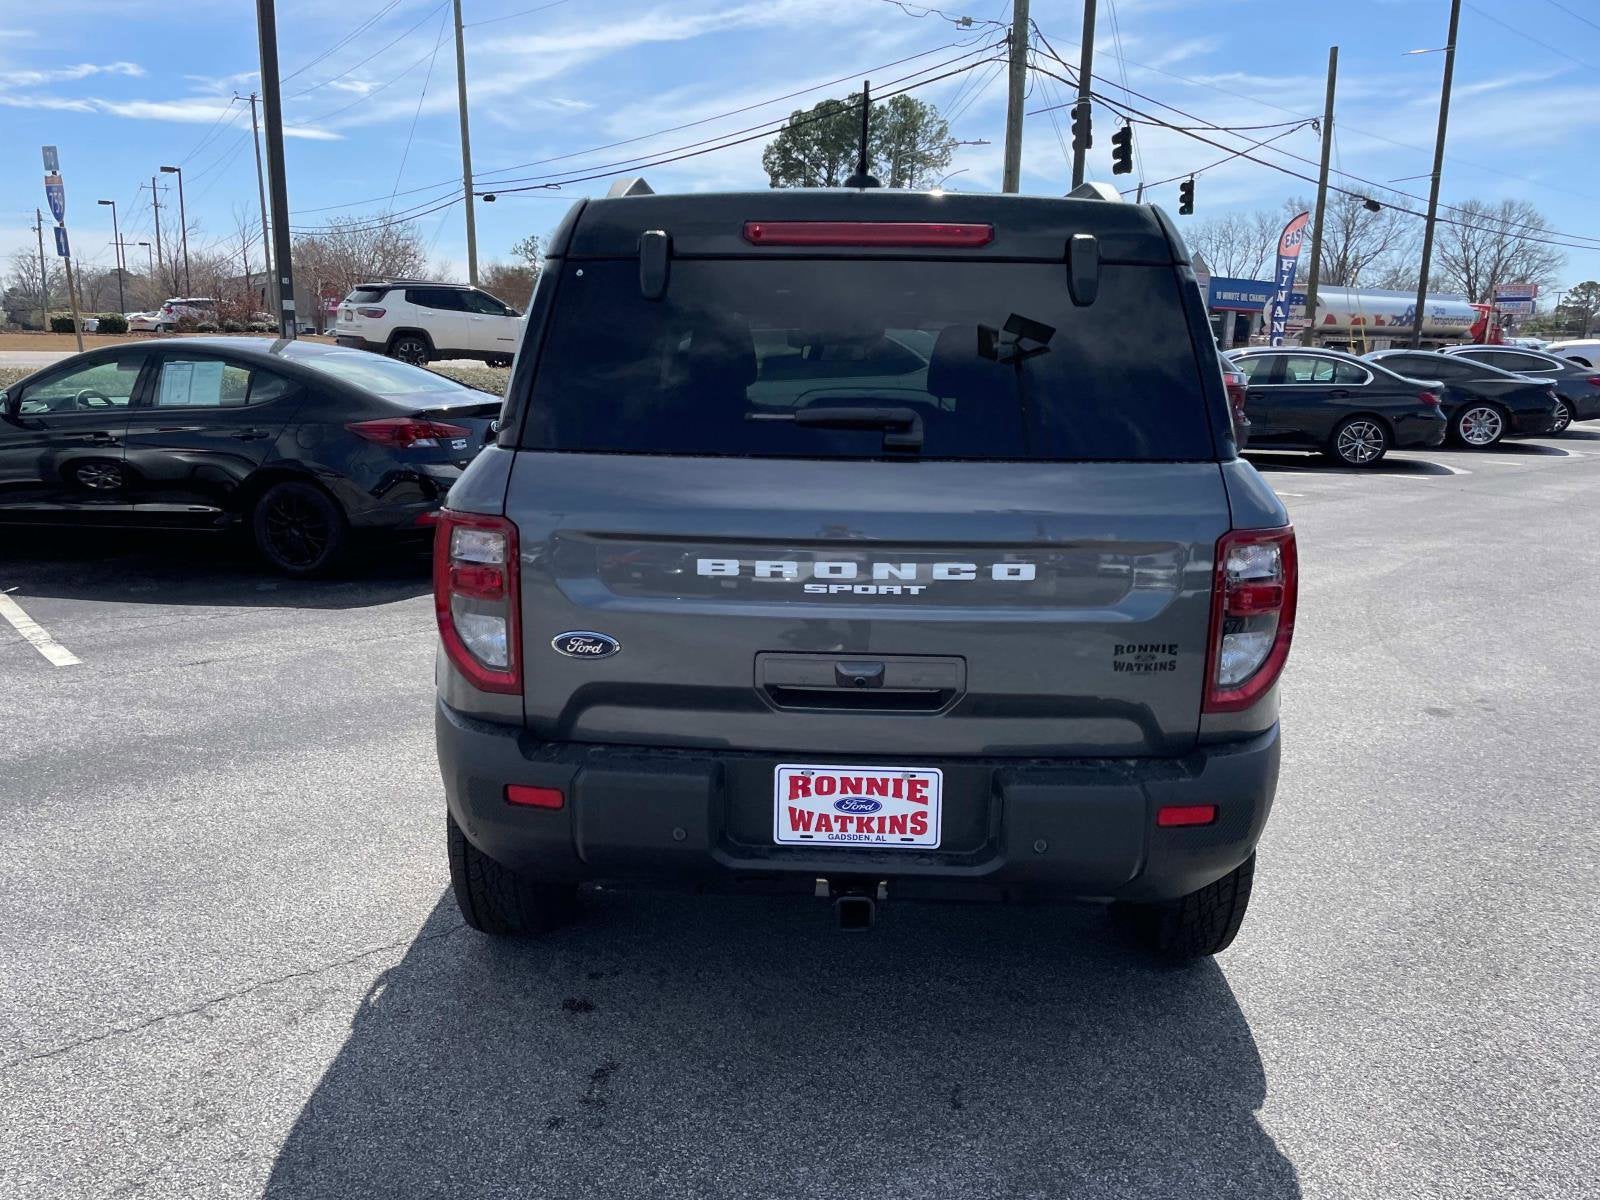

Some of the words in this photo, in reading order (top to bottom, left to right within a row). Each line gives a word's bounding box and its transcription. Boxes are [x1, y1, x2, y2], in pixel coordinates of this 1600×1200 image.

[1285, 226, 1306, 249] EASY
[1222, 291, 1240, 301] MINUTE
[1240, 292, 1249, 302] OIL
[1249, 293, 1267, 303] CHANGE
[696, 558, 1036, 581] BRONCO
[803, 584, 927, 596] SPORT
[566, 637, 604, 654] Ford
[1113, 643, 1179, 656] RONNIE
[1113, 660, 1177, 672] WATKINS
[788, 775, 929, 805] RONNIE
[841, 799, 874, 812] Ford
[788, 806, 928, 836] WATKINS
[827, 833, 873, 842] GADSDEN,
[875, 834, 887, 842] AL
